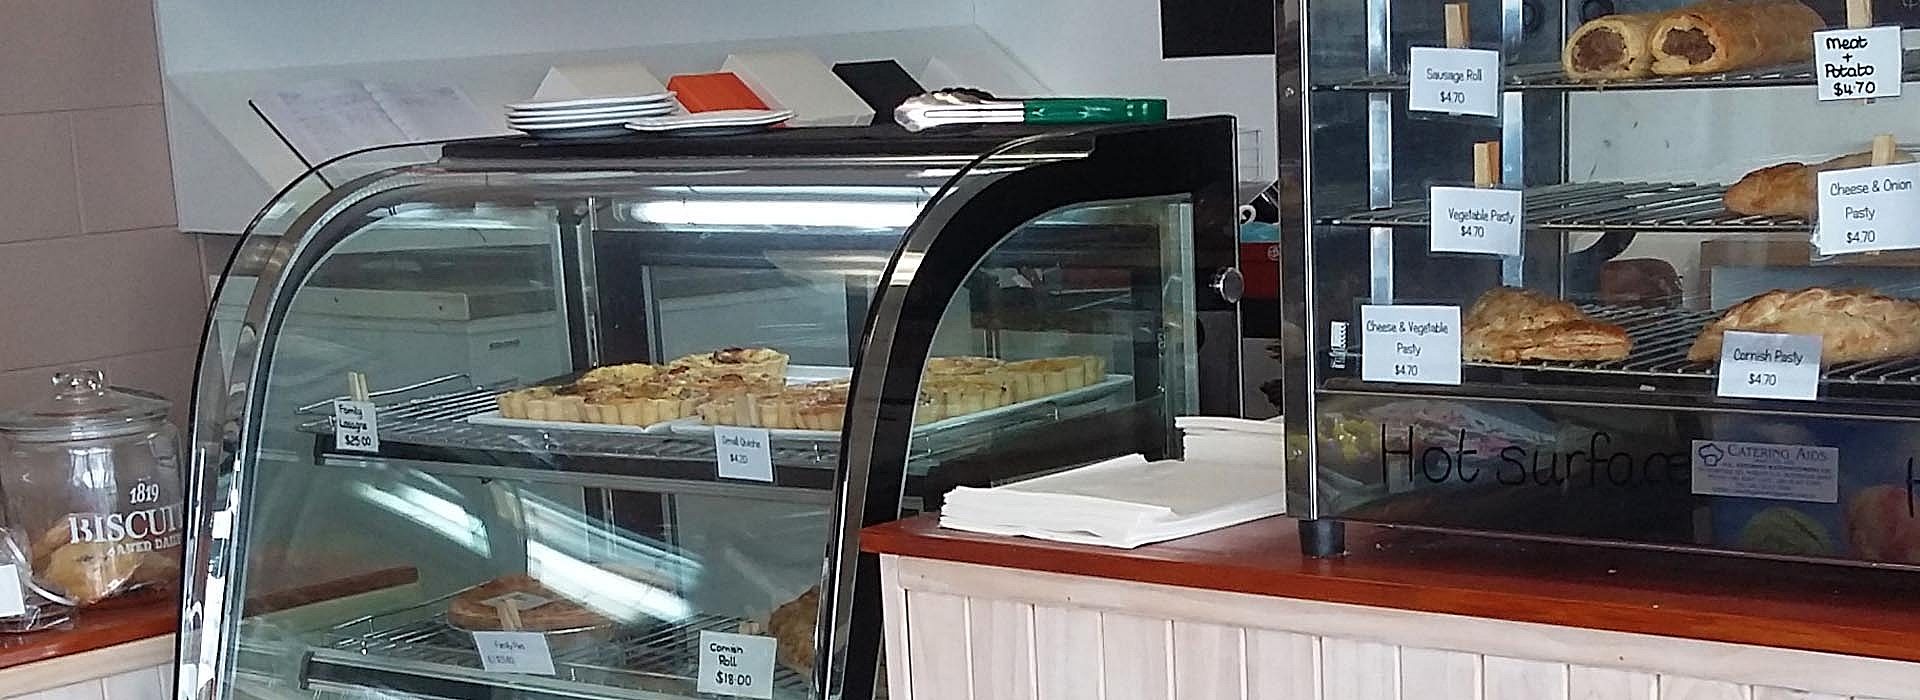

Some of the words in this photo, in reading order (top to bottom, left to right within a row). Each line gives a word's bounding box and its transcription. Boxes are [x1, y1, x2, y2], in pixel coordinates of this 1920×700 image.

[1842, 53, 1853, 63] +
[1426, 68, 1464, 84] Sausage
[1466, 68, 1482, 81] Roll
[1825, 62, 1874, 79] Potato
[1833, 81, 1876, 97] $4.70
[1830, 182, 1869, 196] Cheese
[1872, 180, 1880, 193] &
[1883, 178, 1912, 192] Onion
[1448, 207, 1489, 223] Vegetable
[1490, 209, 1515, 225] Pasty
[1845, 206, 1875, 221] Pasty
[1846, 230, 1876, 244] $4.70
[1366, 320, 1396, 333] Cheese
[1399, 321, 1406, 333] &
[1408, 321, 1449, 336] Vegetable
[1396, 342, 1421, 357] Pasty
[1733, 347, 1773, 362] Cornish
[1774, 349, 1803, 366] Pasty
[1381, 423, 1480, 486] Hot
[1499, 431, 1691, 488] surface
[129, 481, 159, 504] 1819
